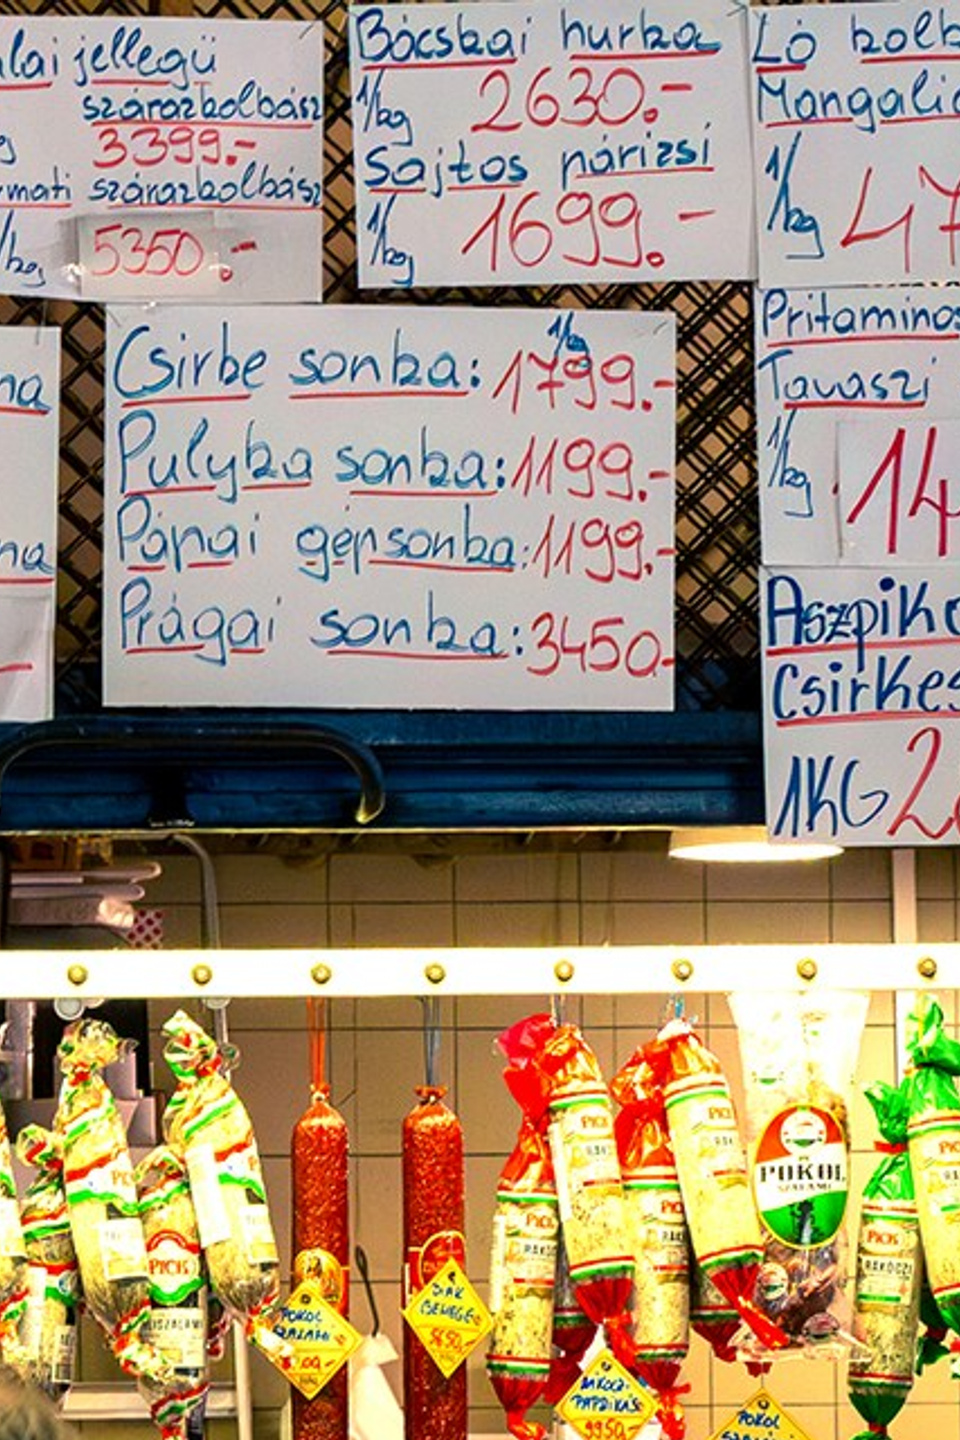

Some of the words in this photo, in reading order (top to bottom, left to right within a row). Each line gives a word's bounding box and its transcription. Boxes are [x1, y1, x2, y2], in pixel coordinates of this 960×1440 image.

[561, 9, 721, 52] hurka
[752, 13, 816, 63] Ló
[83, 80, 322, 121] szárazkolbász
[471, 67, 692, 132] 2630.-
[92, 126, 256, 168] 3399.-
[365, 140, 528, 198] Sajtos
[562, 122, 711, 190] párizsi
[88, 161, 321, 207] szárazkolbász
[462, 192, 715, 271] 1699.-
[114, 321, 266, 400] Csirke
[758, 350, 937, 400] Tavaszi
[119, 409, 311, 502] Pulyka
[118, 495, 259, 572] Pápai
[120, 577, 280, 665] Prágai
[774, 755, 890, 837] 1KG
[149, 1260, 189, 1275] PICK
